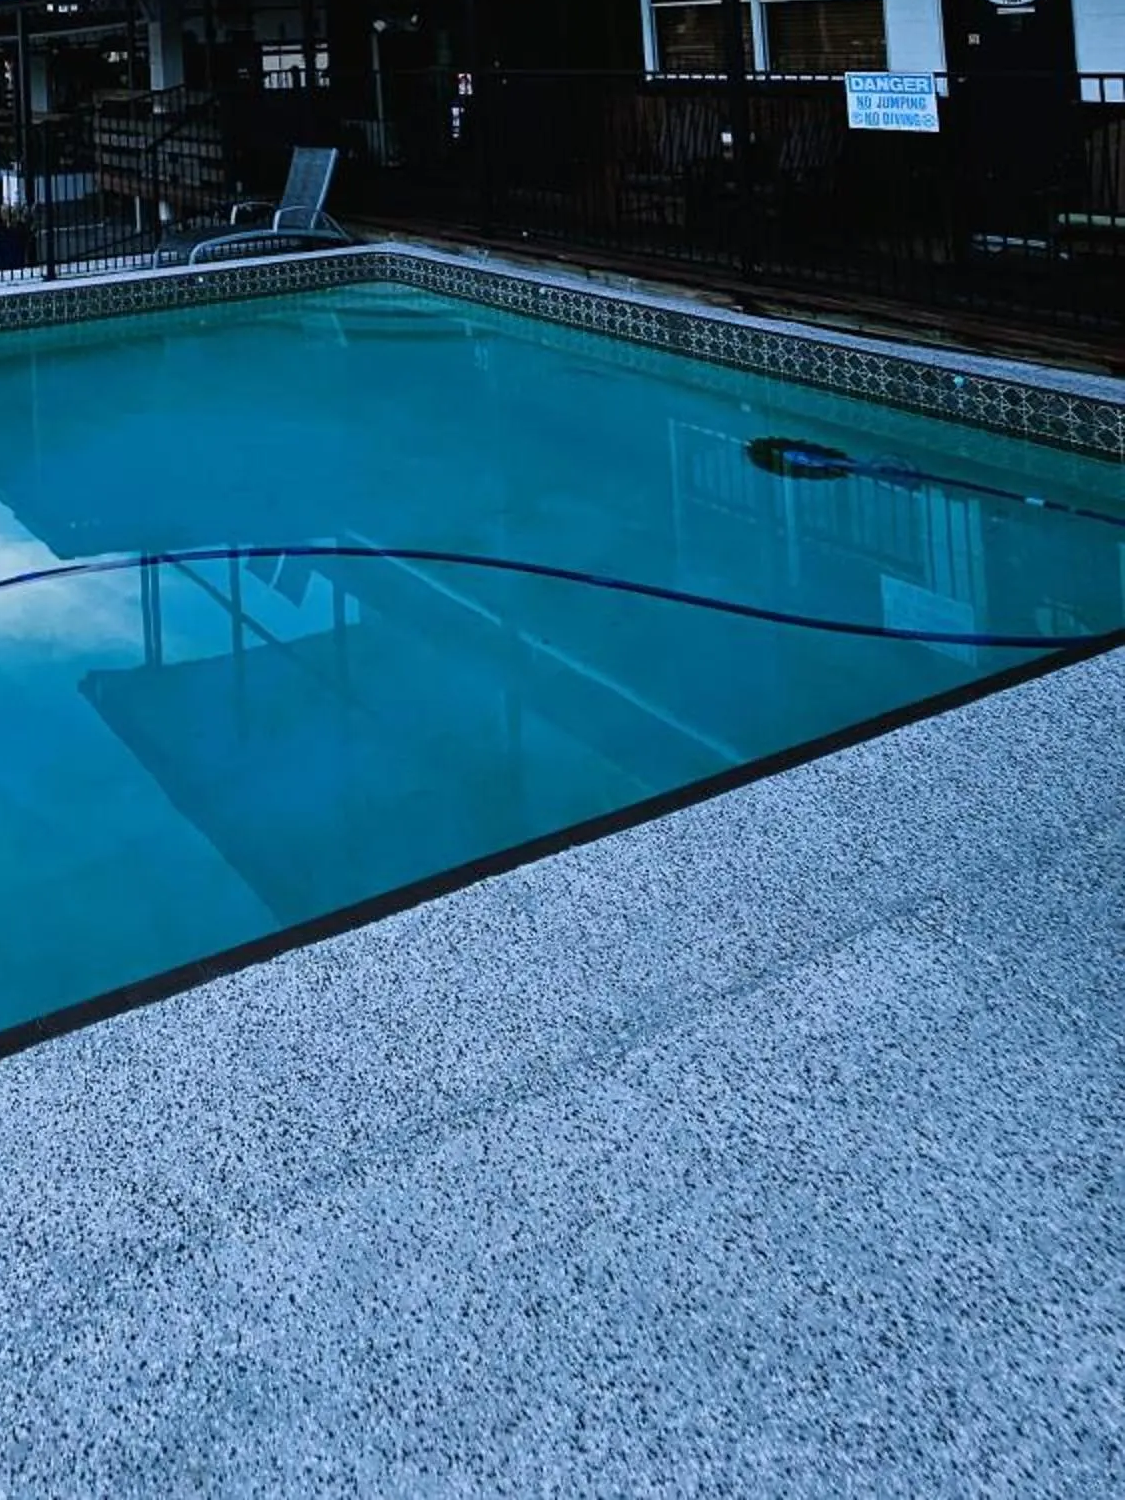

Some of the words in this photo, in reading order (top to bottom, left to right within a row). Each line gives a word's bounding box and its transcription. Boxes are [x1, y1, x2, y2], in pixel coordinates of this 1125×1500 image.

[851, 77, 930, 92] DANGER
[856, 96, 872, 109] NO
[876, 96, 927, 110] JUMPING
[864, 112, 880, 126] NO
[882, 112, 921, 126] DIVING
